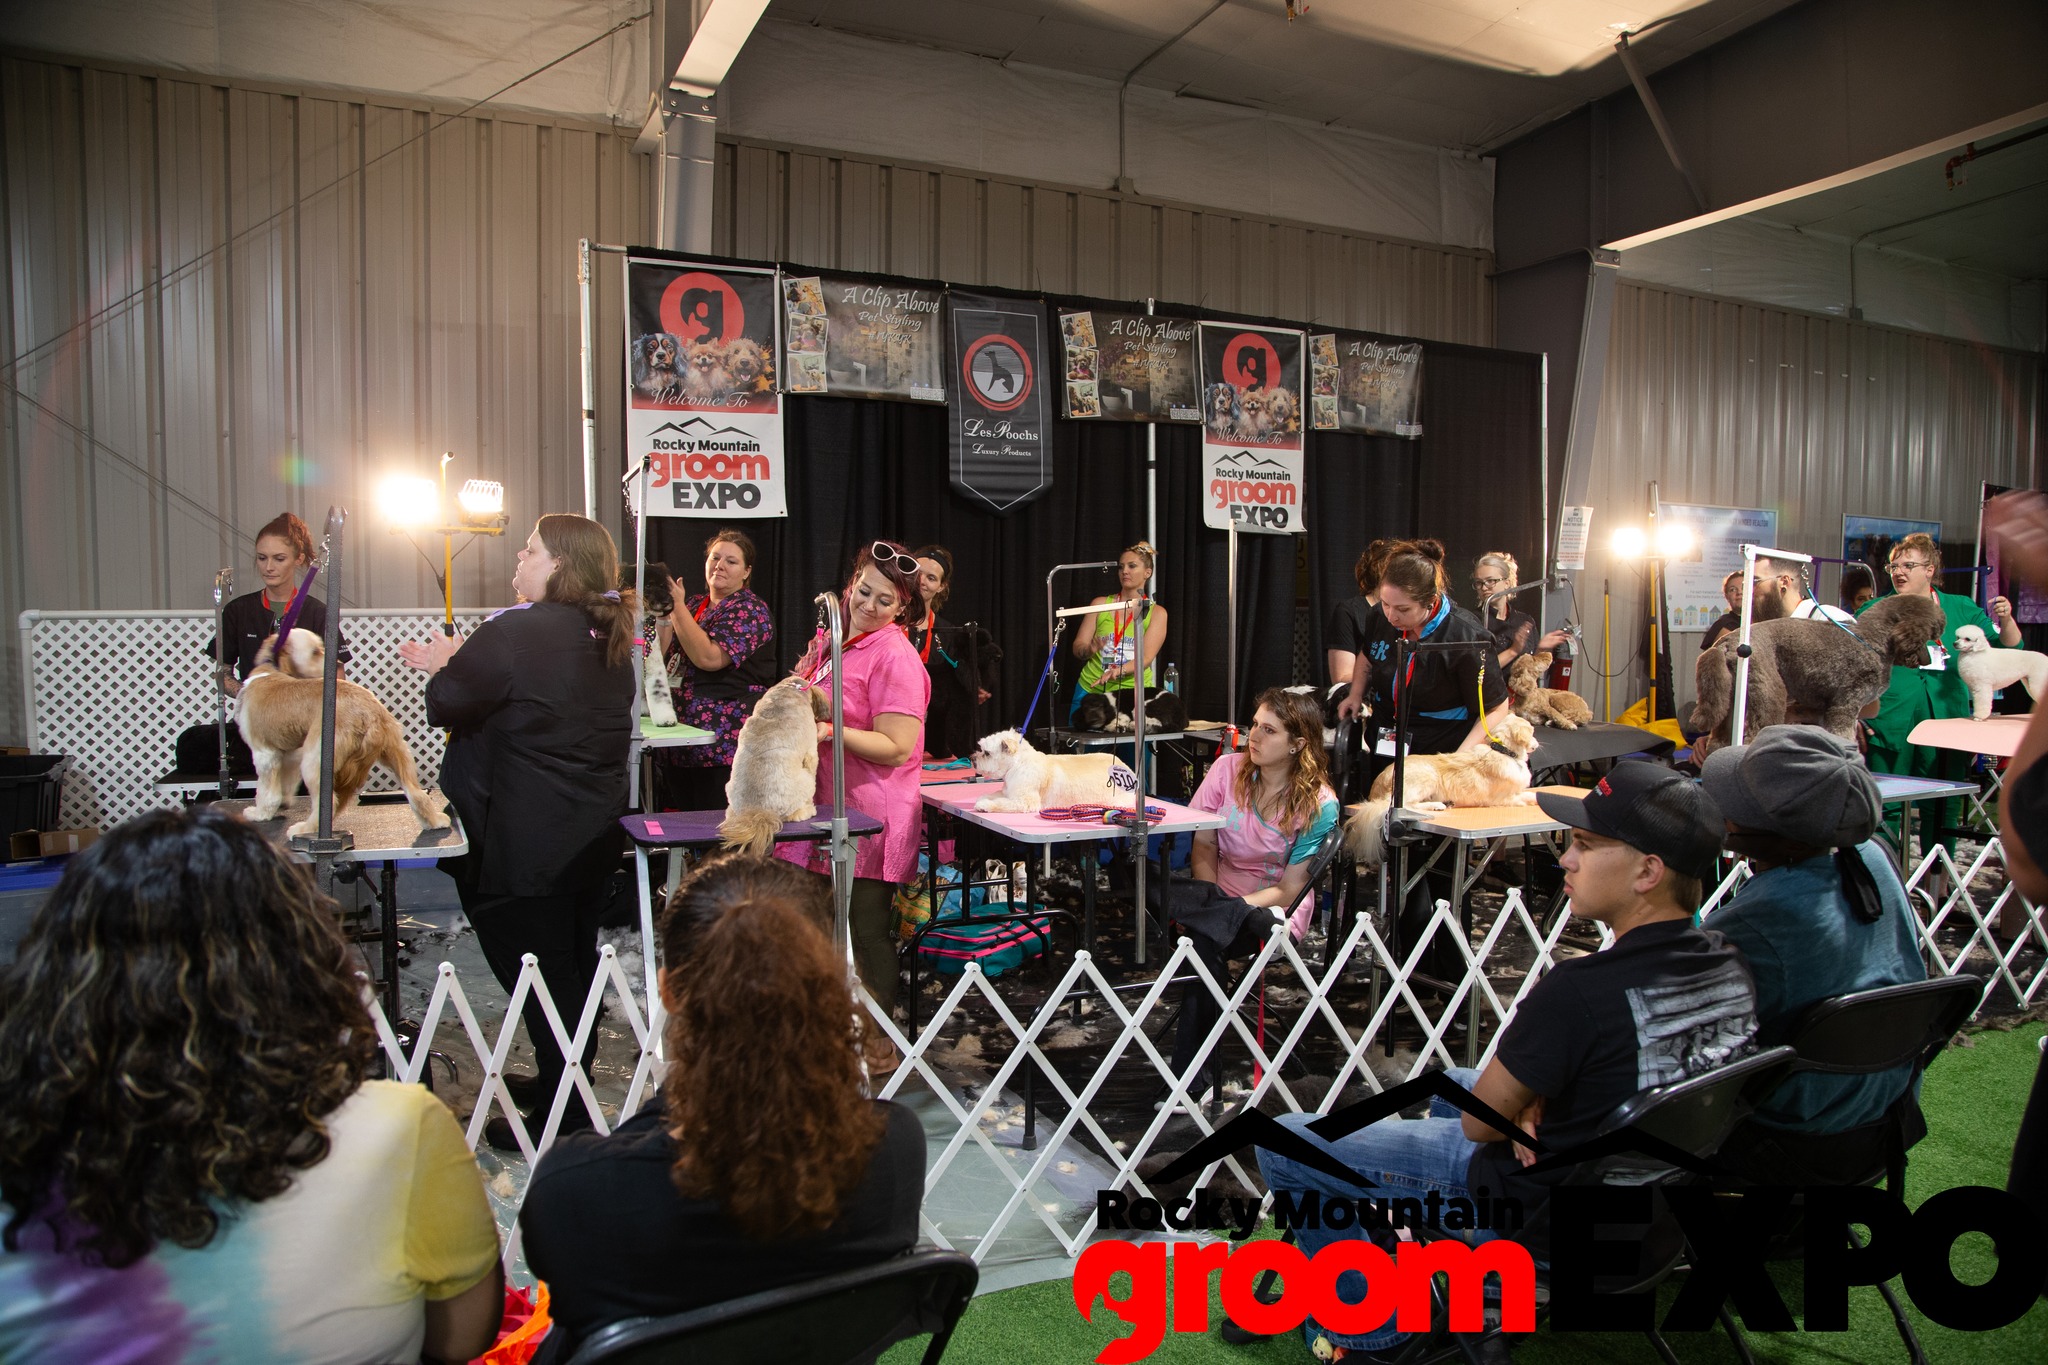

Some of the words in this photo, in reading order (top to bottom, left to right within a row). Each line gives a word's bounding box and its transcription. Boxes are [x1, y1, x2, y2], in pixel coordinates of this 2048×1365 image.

[842, 286, 858, 304] A
[861, 286, 891, 317] Clip
[895, 290, 940, 314] Above
[859, 311, 878, 322] Pet
[881, 314, 922, 332] Styling
[1110, 319, 1123, 335] A
[1126, 317, 1151, 346] Clip
[1154, 320, 1191, 341] Above
[1124, 341, 1141, 350] Pet
[1143, 343, 1177, 358] Styling
[1349, 341, 1361, 356] A
[1362, 341, 1384, 367] Clip
[1385, 344, 1418, 364] Above
[1360, 361, 1375, 370] Pet
[1376, 363, 1406, 378] Styling
[651, 388, 720, 406] Welcome
[726, 391, 751, 408] To
[963, 418, 992, 438] Les
[992, 420, 1039, 441] Poochs
[1216, 427, 1264, 444] Welcome
[1266, 431, 1283, 445] To
[652, 438, 696, 453] Rocky
[698, 440, 760, 452] Mountain
[972, 443, 999, 456] Luxury
[1000, 444, 1032, 457] Products
[646, 452, 770, 488] groom
[1215, 467, 1245, 481] Rocky
[1246, 469, 1291, 481] Mountain
[672, 481, 762, 510] EXPO
[1210, 478, 1296, 509] groom
[1230, 504, 1289, 529] EXPO
